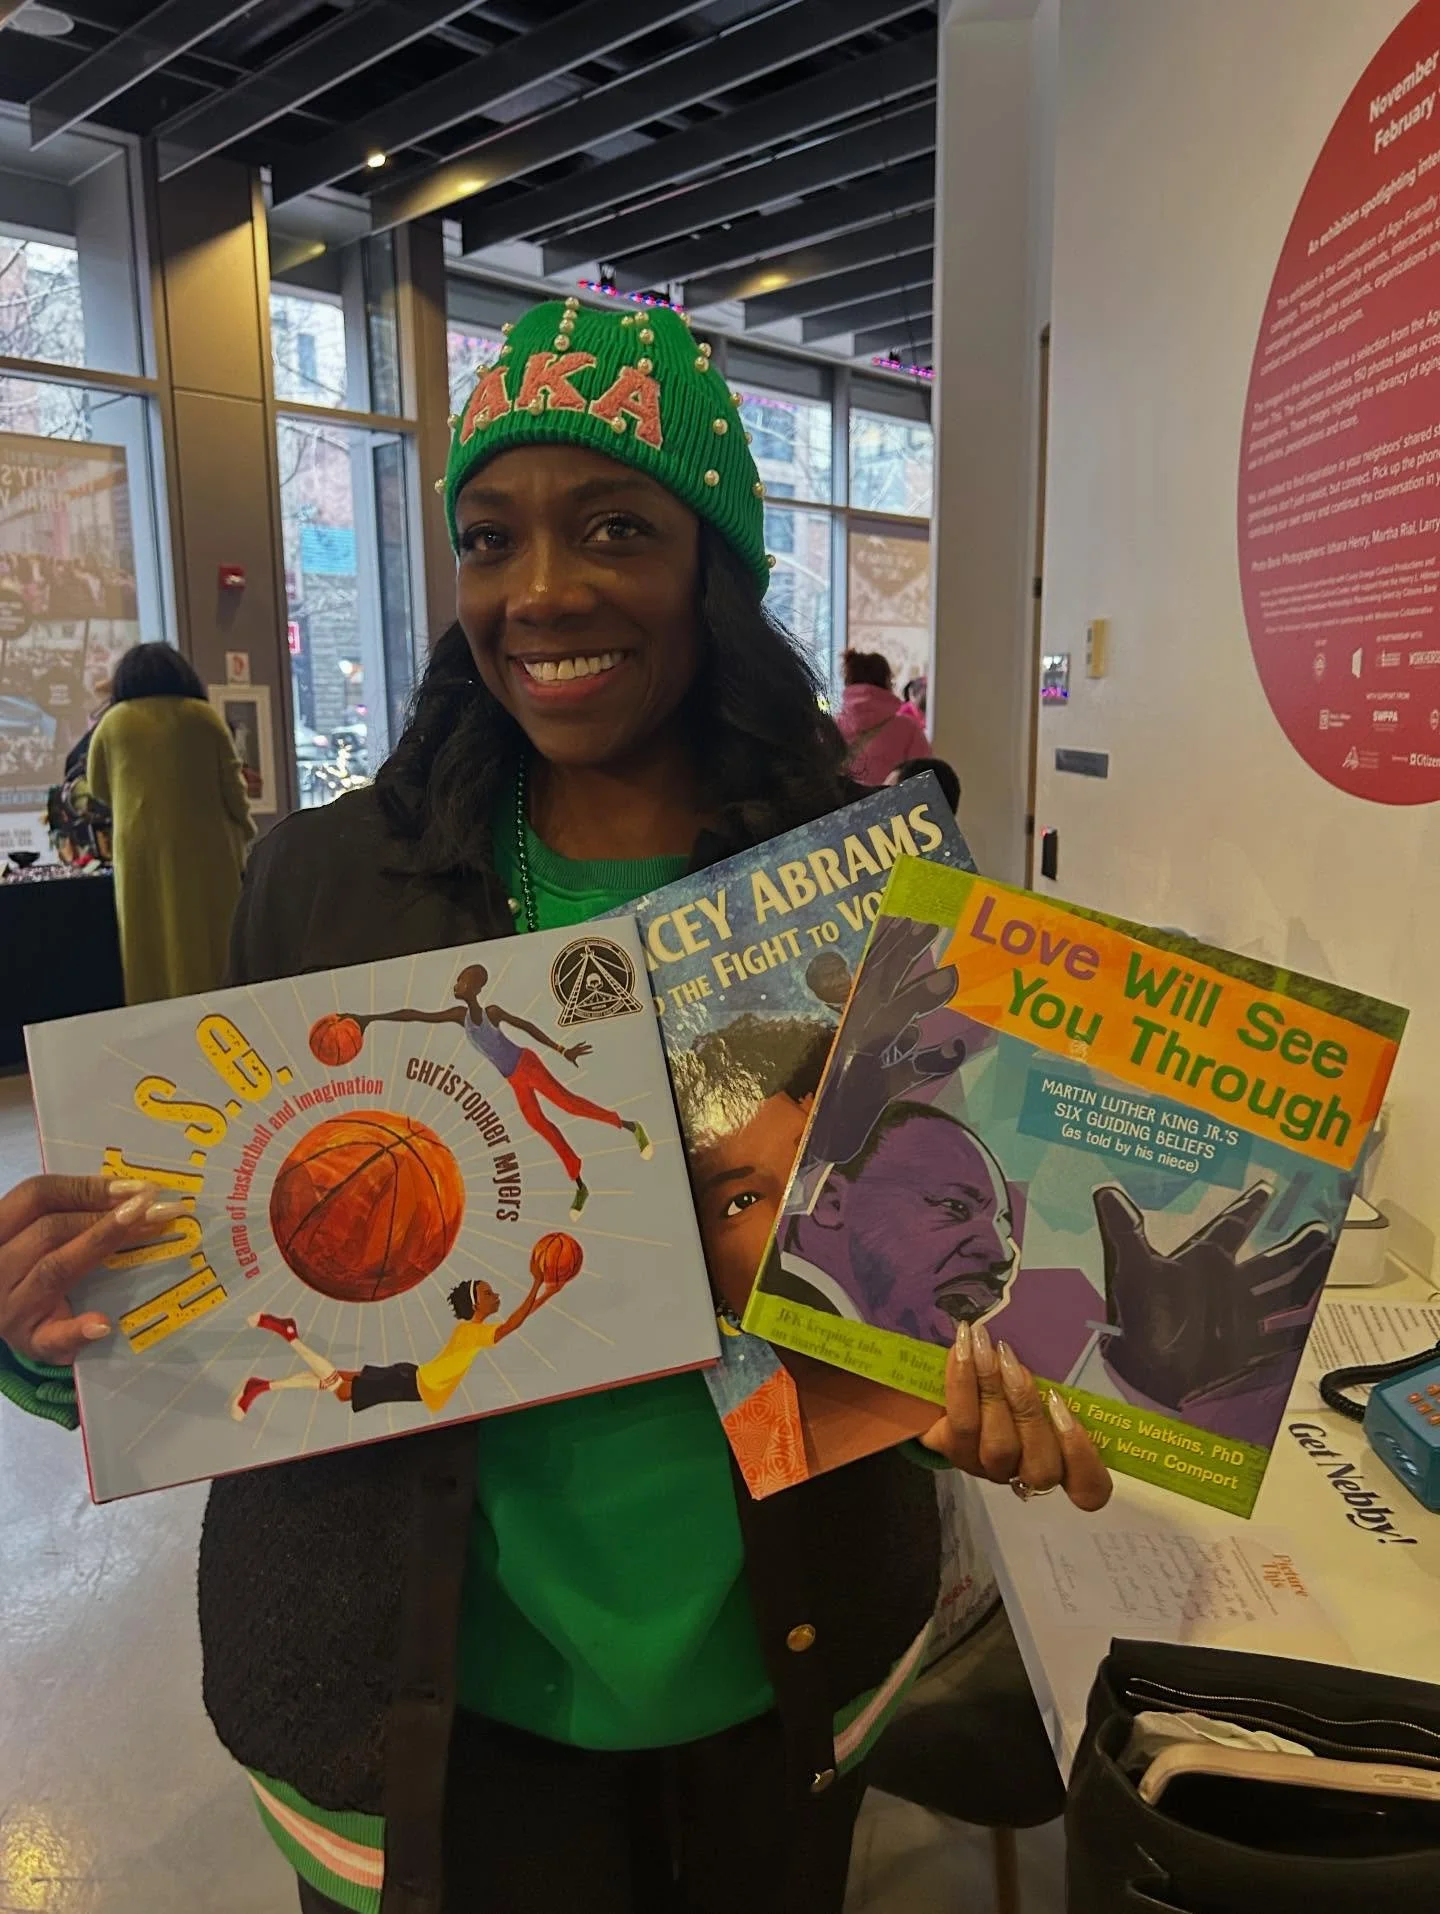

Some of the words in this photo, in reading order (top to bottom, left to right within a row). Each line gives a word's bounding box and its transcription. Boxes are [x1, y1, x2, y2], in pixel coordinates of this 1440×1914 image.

[1369, 49, 1440, 123] November
[1374, 91, 1436, 154] February
[1320, 210, 1360, 247] exhibition
[1360, 167, 1416, 219] spotlighting
[1410, 319, 1424, 334] the
[459, 351, 663, 450] AKA
[1376, 373, 1407, 395] vibrancy
[1409, 365, 1418, 380] of
[1403, 425, 1432, 447] shared
[1372, 462, 1388, 477] Pick
[1390, 463, 1399, 476] up
[1401, 456, 1415, 470] the
[1374, 476, 1424, 498] conversation
[1371, 525, 1398, 543] Martha
[1400, 522, 1417, 537] Rial,
[1419, 517, 1439, 533] Larry
[750, 804, 943, 925] ABRAMS
[668, 975, 714, 1009] THE
[711, 928, 802, 989] FIGHT
[806, 920, 840, 949] TO
[836, 885, 888, 933] VO
[968, 895, 1101, 981] Love
[1122, 951, 1223, 1028] Will
[1236, 1001, 1349, 1080] See
[1006, 967, 1104, 1046] You
[1127, 1016, 1352, 1148] Through
[268, 1101, 296, 1131] and
[292, 1076, 384, 1112] imagination
[1041, 1078, 1097, 1106] MARTIN
[1100, 1095, 1156, 1123] LUTHER
[1160, 1112, 1200, 1135] KING
[1202, 1123, 1240, 1147] JR.'S
[1054, 1102, 1083, 1122] SIX
[1086, 1111, 1151, 1141] GUIDING
[1155, 1130, 1216, 1160] BELIEFS
[1061, 1122, 1082, 1140] (as
[1086, 1130, 1111, 1149] told
[1115, 1139, 1132, 1157] by
[1134, 1145, 1154, 1161] his
[1157, 1151, 1201, 1175] niece)
[227, 1124, 273, 1202] basketball
[225, 1205, 247, 1220] of
[231, 1226, 258, 1267] game
[244, 1265, 260, 1280] a
[1087, 1404, 1133, 1431] Farris
[1138, 1420, 1205, 1455] Watkins,
[1212, 1445, 1244, 1466] PhD
[1117, 1438, 1158, 1463] Wern
[1164, 1454, 1239, 1489] Comport
[1288, 1423, 1344, 1458] Get
[1316, 1463, 1418, 1544] Nebby!
[1272, 1553, 1309, 1597] Picture
